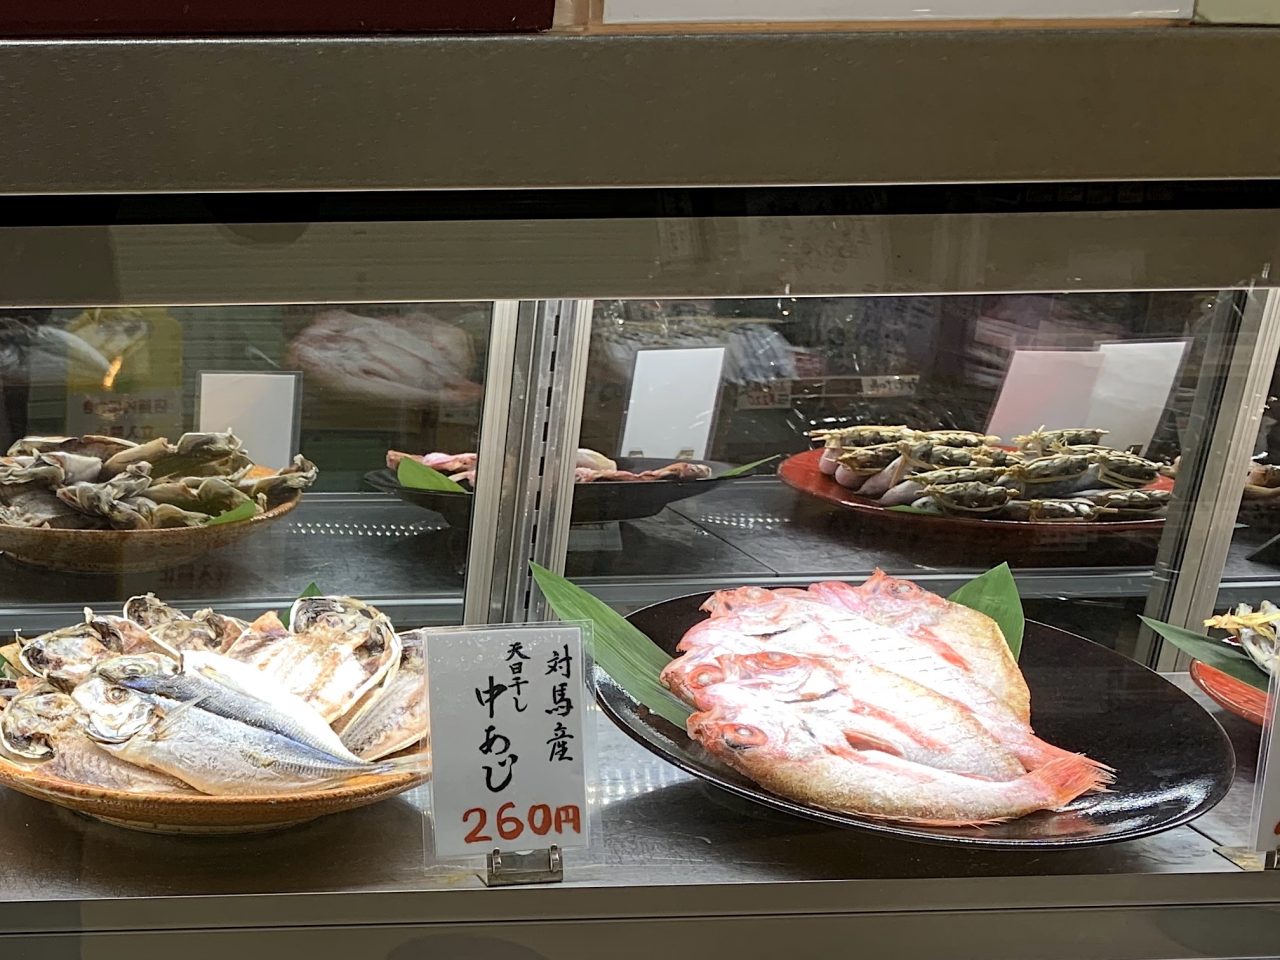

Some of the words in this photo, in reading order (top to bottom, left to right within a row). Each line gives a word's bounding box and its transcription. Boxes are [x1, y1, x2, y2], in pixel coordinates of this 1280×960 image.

[505, 641, 532, 713] 天日干し
[544, 644, 575, 763] 対馬産
[475, 675, 519, 793] 中あじ
[462, 801, 582, 844] 260円
